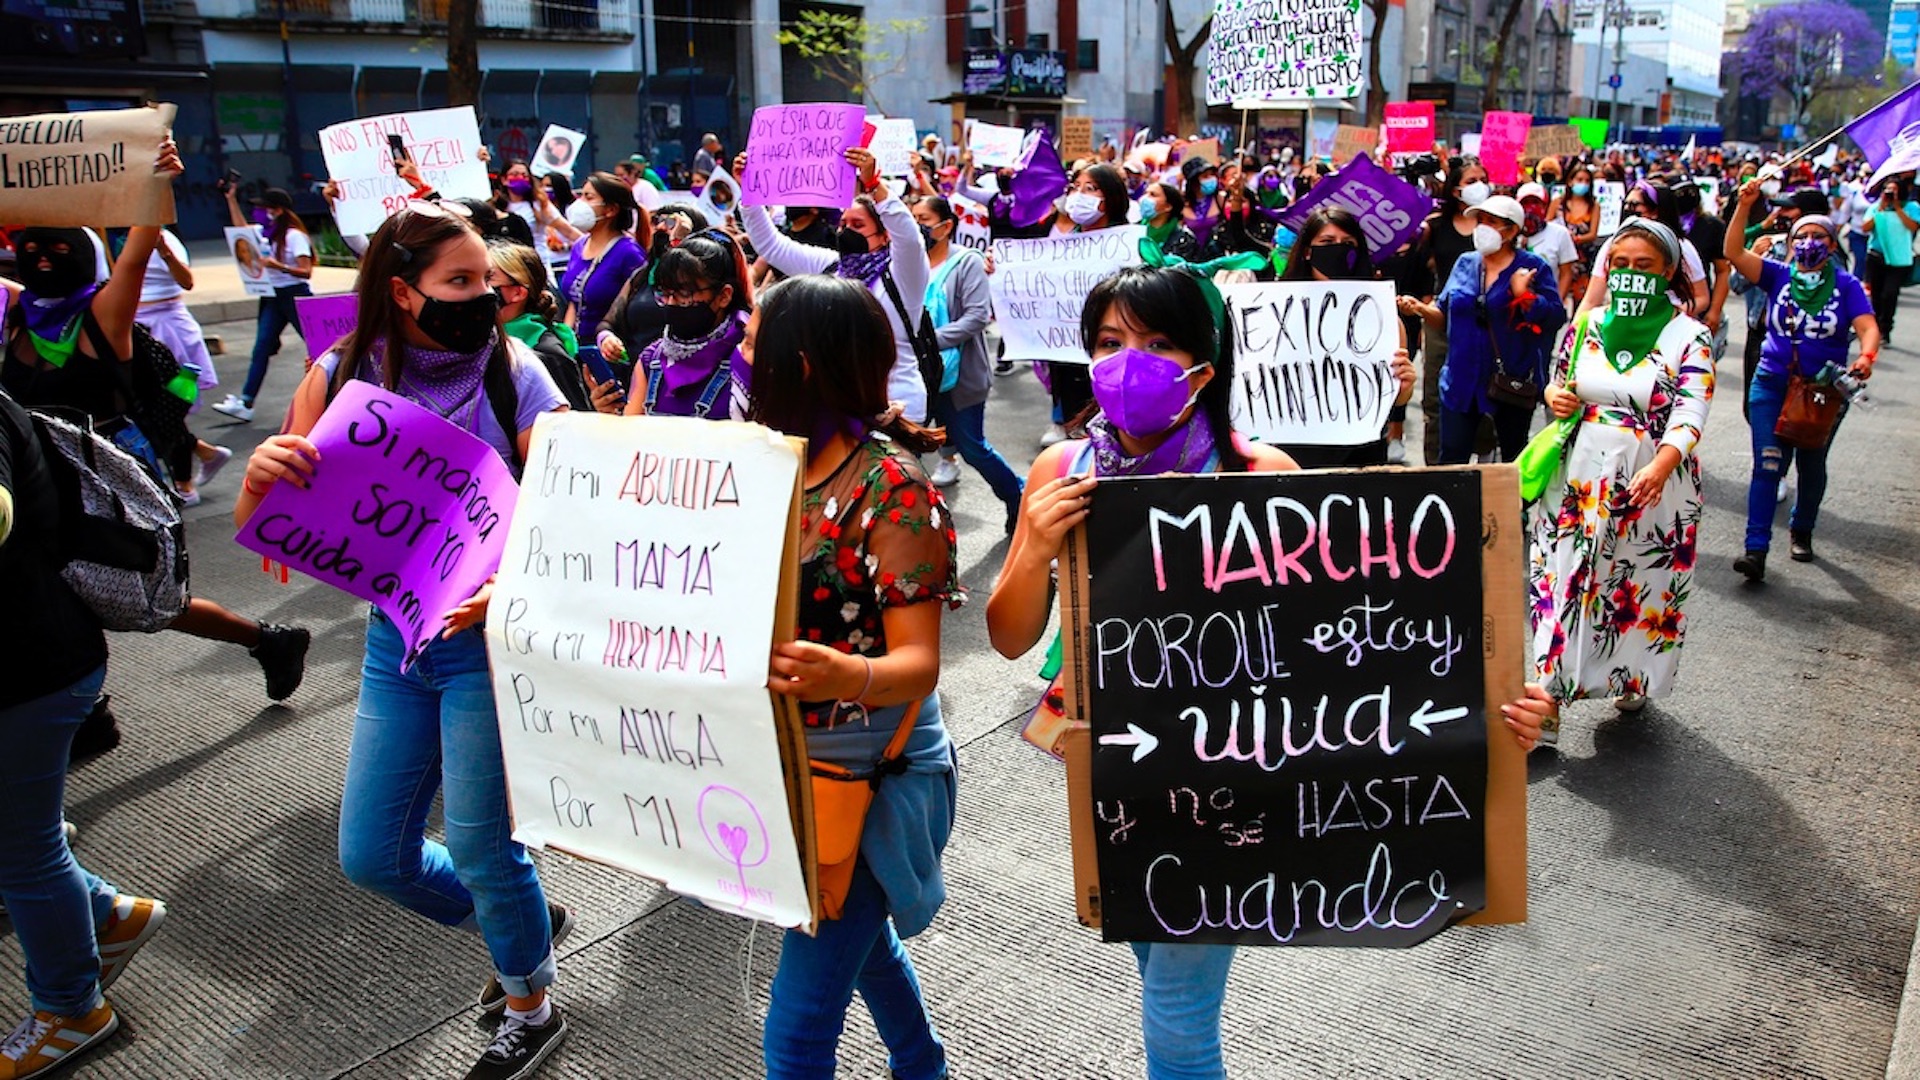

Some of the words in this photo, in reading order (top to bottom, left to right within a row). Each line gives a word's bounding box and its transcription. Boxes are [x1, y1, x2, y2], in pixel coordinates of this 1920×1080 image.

[328, 126, 358, 154] NOS
[360, 116, 415, 147] FALTA
[761, 138, 798, 163] HARÁ
[800, 136, 845, 160] PAGAR
[815, 109, 847, 134] QUE
[995, 239, 1014, 265] SE
[1021, 239, 1045, 264] LO
[1052, 230, 1132, 266] DEBEMOS
[1003, 269, 1017, 296] A
[1024, 269, 1057, 299] LAS
[1009, 301, 1041, 321] QUE
[1616, 297, 1648, 317] EY!
[348, 398, 402, 459] Si
[403, 443, 500, 545] mañana
[539, 437, 562, 499] Por
[568, 469, 600, 500] mi
[618, 450, 740, 508] ABUELITA
[255, 511, 365, 579] cuida
[370, 570, 401, 600] a
[352, 482, 440, 548] SOY
[432, 526, 461, 581] YO
[523, 525, 554, 579] Por
[562, 552, 594, 582] mi
[614, 540, 722, 596] MAMÁ
[1148, 493, 1457, 593] MARCHO
[503, 596, 538, 655] Por
[552, 629, 584, 661] mi
[602, 616, 729, 680] HERMANA
[1303, 594, 1463, 677] estoy
[511, 672, 555, 734] Por
[568, 713, 604, 745] mi
[618, 704, 724, 771] AMIGA
[1179, 684, 1406, 772] viva
[549, 775, 596, 829] Por
[622, 793, 682, 850] MI
[1097, 799, 1138, 846] y
[1168, 785, 1236, 827] no
[1218, 812, 1267, 847] sé
[1297, 774, 1472, 839] HASTA
